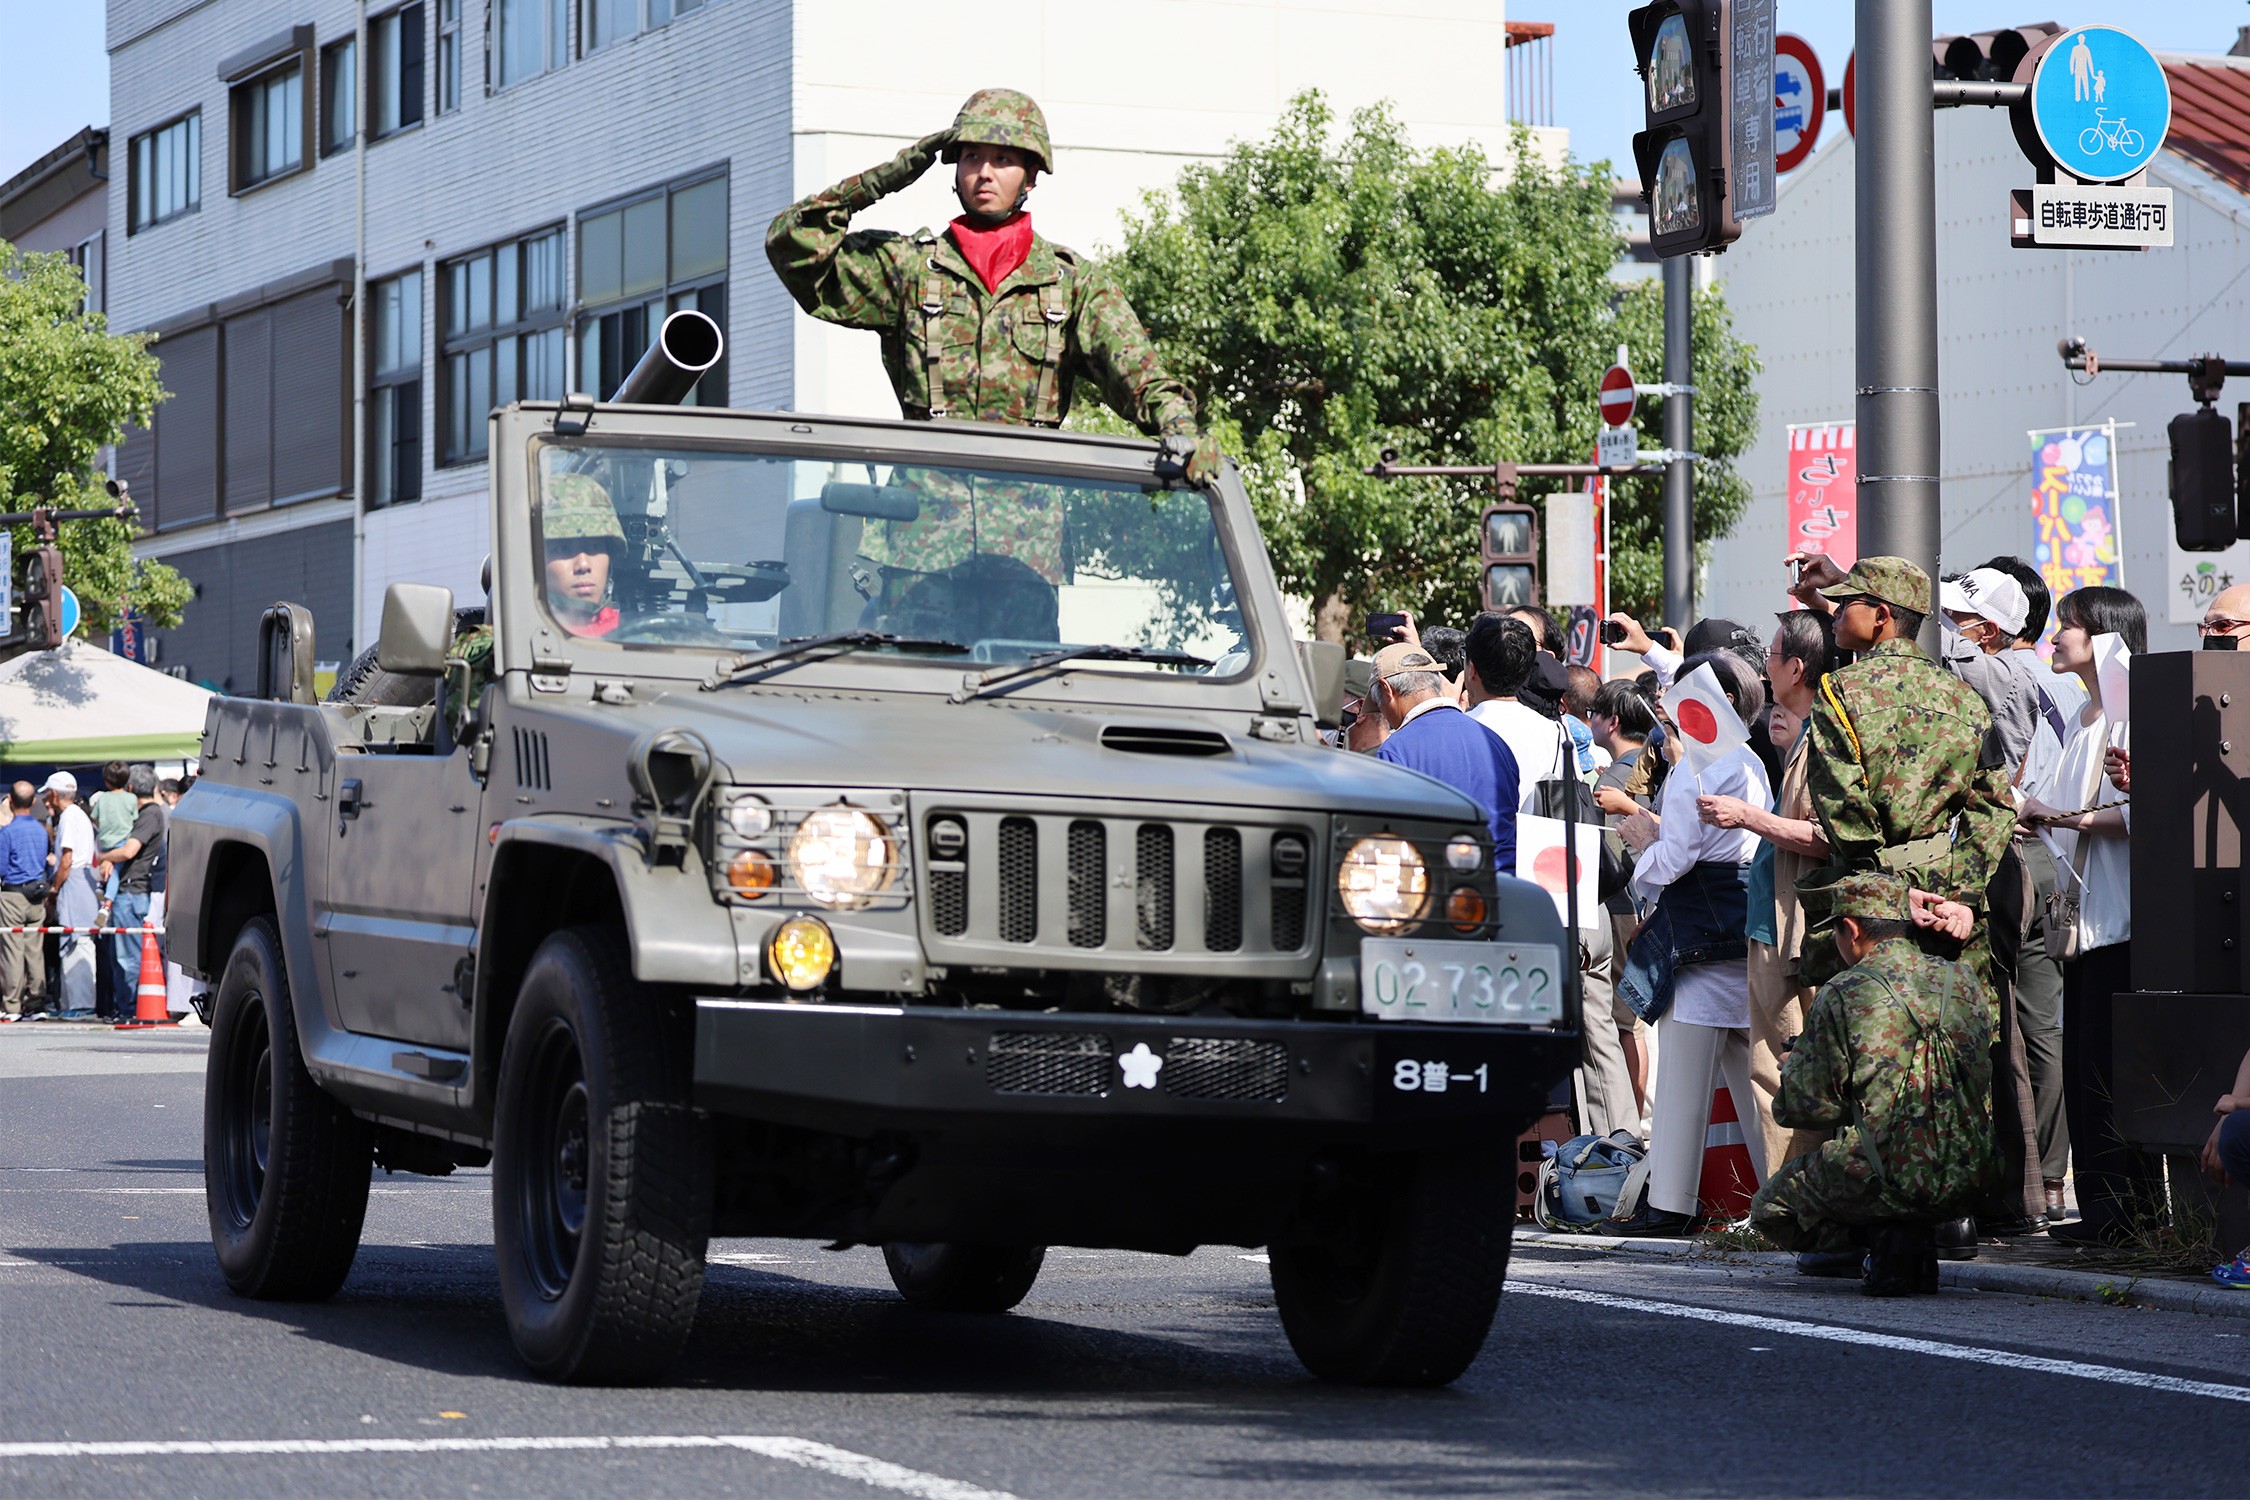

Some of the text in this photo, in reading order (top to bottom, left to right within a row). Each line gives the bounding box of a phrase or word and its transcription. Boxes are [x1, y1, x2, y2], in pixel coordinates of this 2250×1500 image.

[1753, 0, 1769, 103] 行者
[1744, 114, 1760, 201] 専用
[2041, 200, 2167, 231] 自転車歩道通行可
